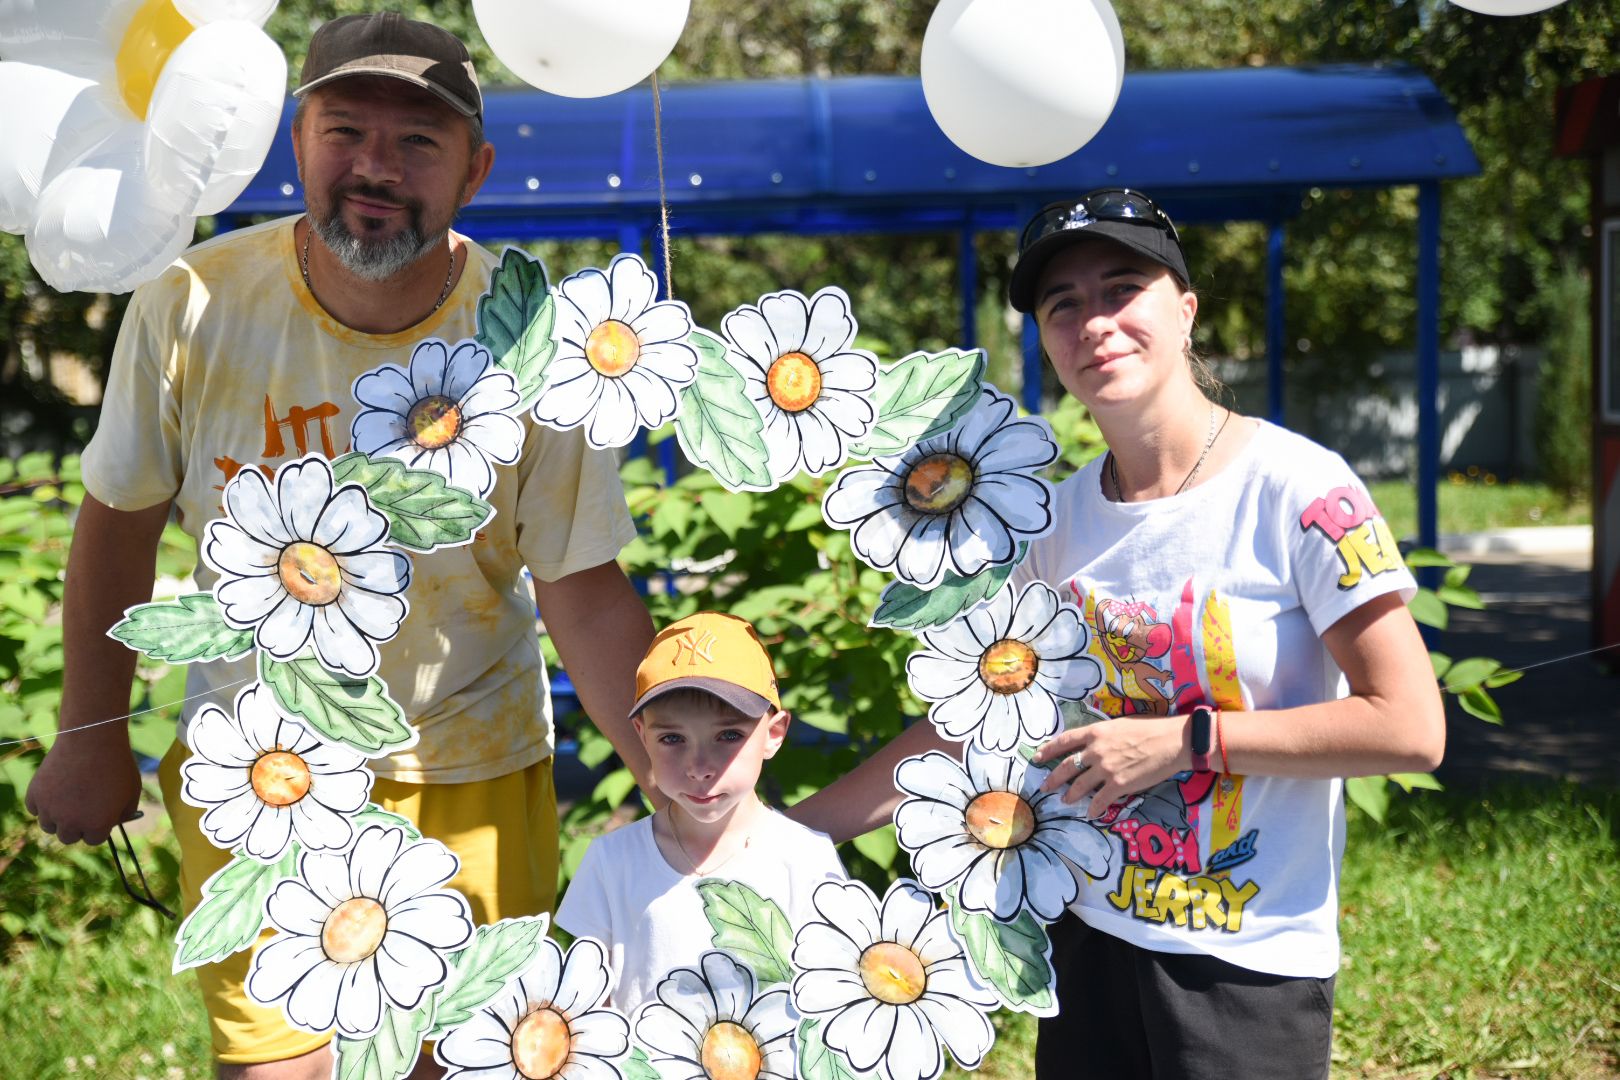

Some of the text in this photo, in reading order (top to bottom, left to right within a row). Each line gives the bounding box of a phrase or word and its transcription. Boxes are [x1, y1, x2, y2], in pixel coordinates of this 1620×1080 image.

[671, 630, 717, 666] NY
[1110, 818, 1260, 874] TOM and
[1106, 865, 1260, 932] JERRY
